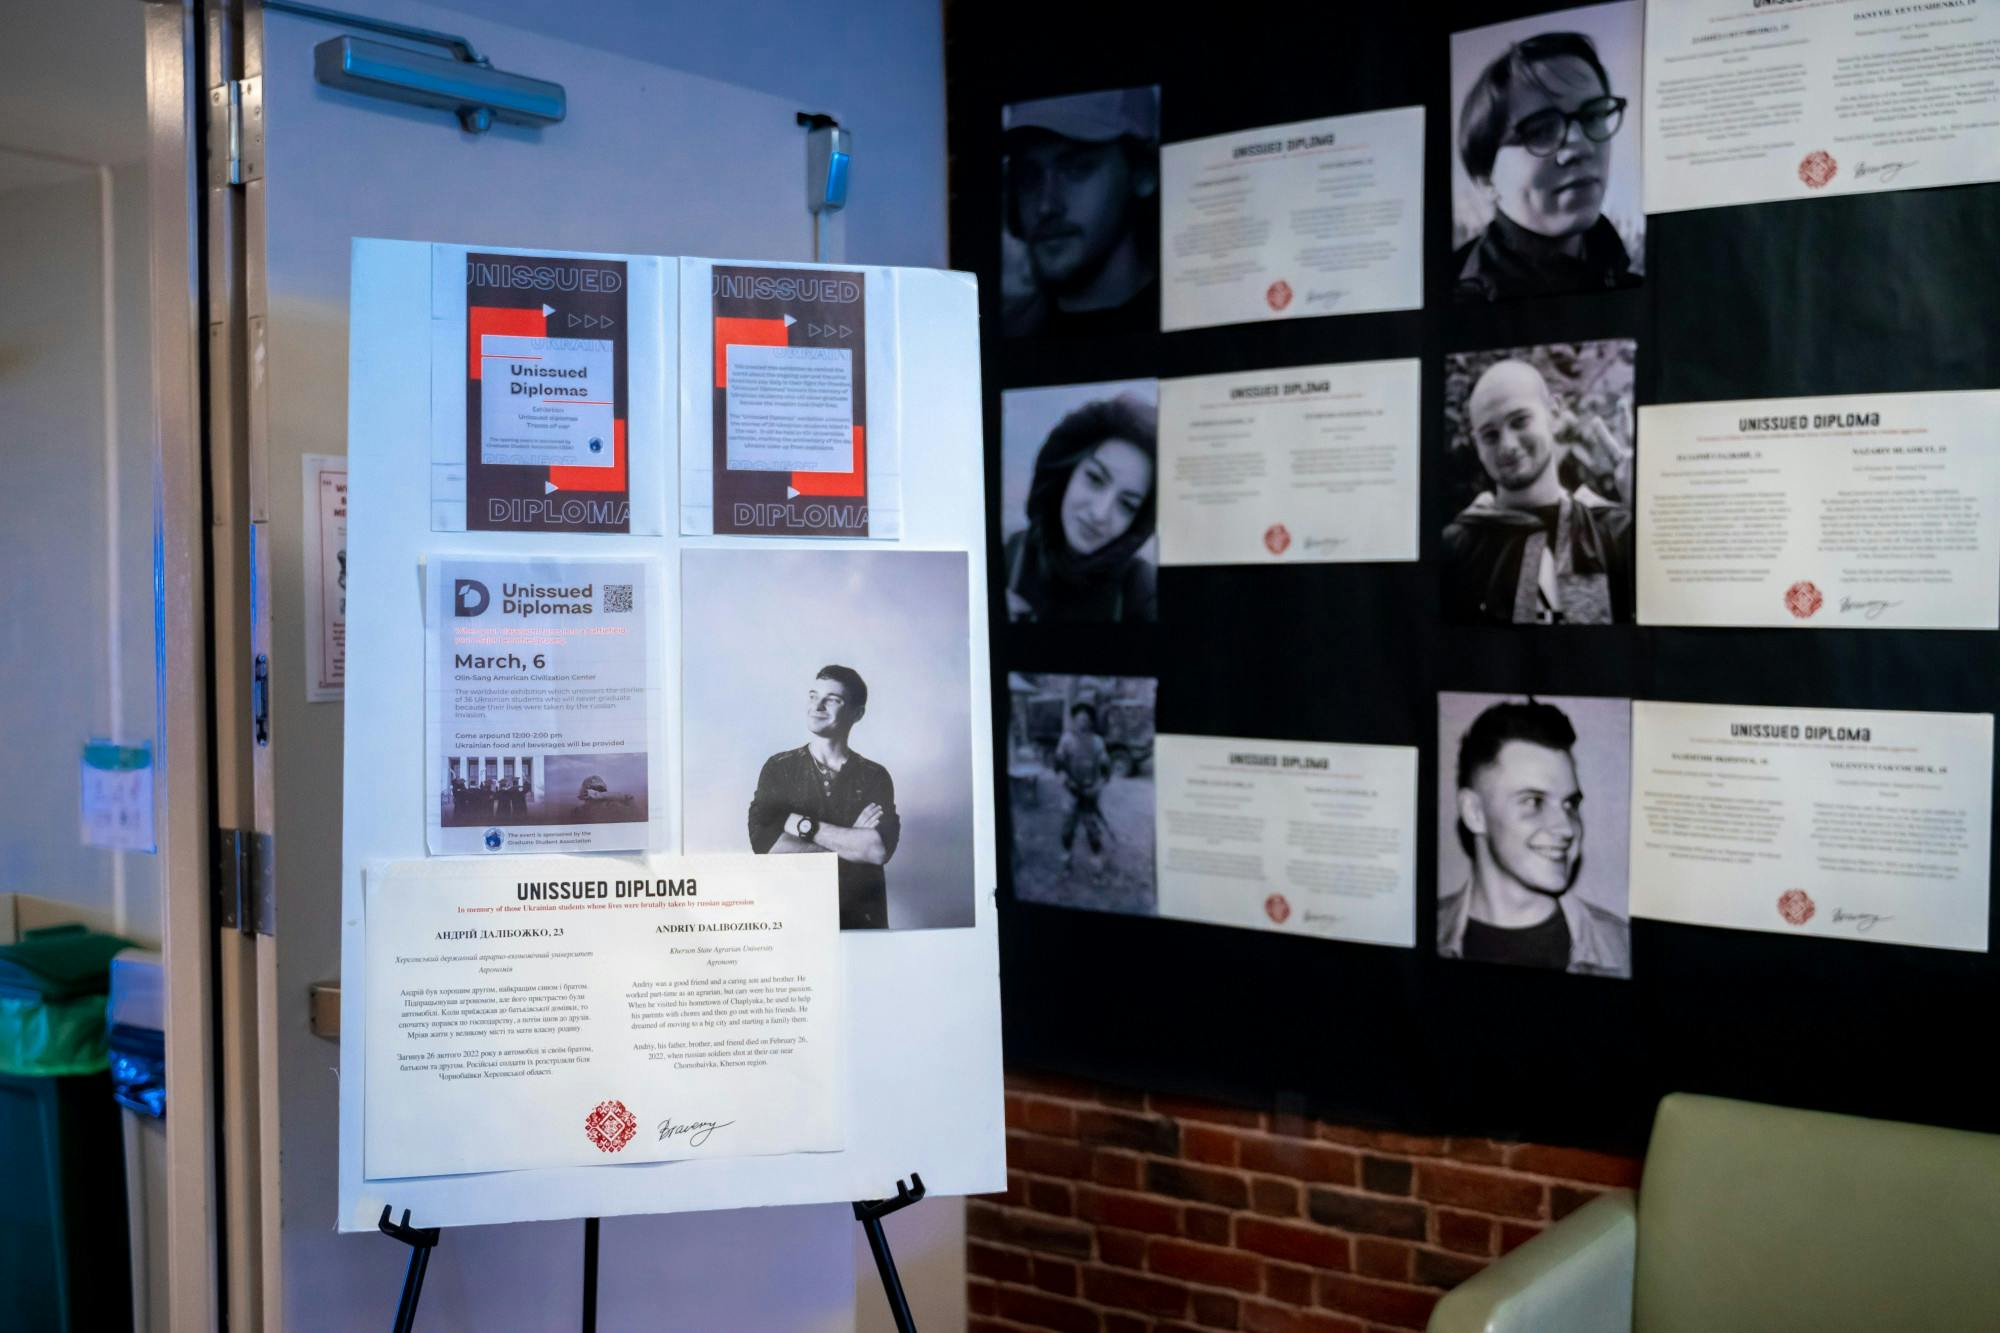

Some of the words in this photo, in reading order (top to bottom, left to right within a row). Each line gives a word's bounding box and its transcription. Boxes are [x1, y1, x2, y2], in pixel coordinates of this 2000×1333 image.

[510, 365, 587, 378] Unissued
[510, 382, 588, 398] Diplomas
[1739, 416, 1808, 432] UNISSUED
[502, 583, 592, 598] Unissued
[503, 600, 592, 617] Diplomas
[455, 654, 526, 671] March,
[534, 654, 545, 668] 6
[455, 674, 492, 682] Olin-Sang
[1731, 724, 1800, 739] UNISSUED
[526, 740, 566, 748] beverages
[592, 739, 624, 748] provided
[517, 881, 608, 900] UNISSUED
[558, 902, 586, 910] students
[640, 900, 666, 909] brutally
[688, 899, 696, 908] by
[721, 898, 754, 907] aggression
[656, 924, 696, 932] ANDRIY
[698, 921, 770, 932] DALIBOZHKO,
[772, 920, 782, 929] 23
[435, 930, 478, 940] АНДРІЙ
[553, 927, 564, 936] 23
[728, 976, 747, 986] caring
[750, 1006, 764, 1014] with
[666, 1020, 690, 1028] moving
[716, 1018, 728, 1027] city
[741, 1016, 764, 1026] starting
[770, 1016, 790, 1024] family
[726, 1038, 744, 1046] friend
[746, 1037, 759, 1045] died
[770, 1036, 796, 1045] February
